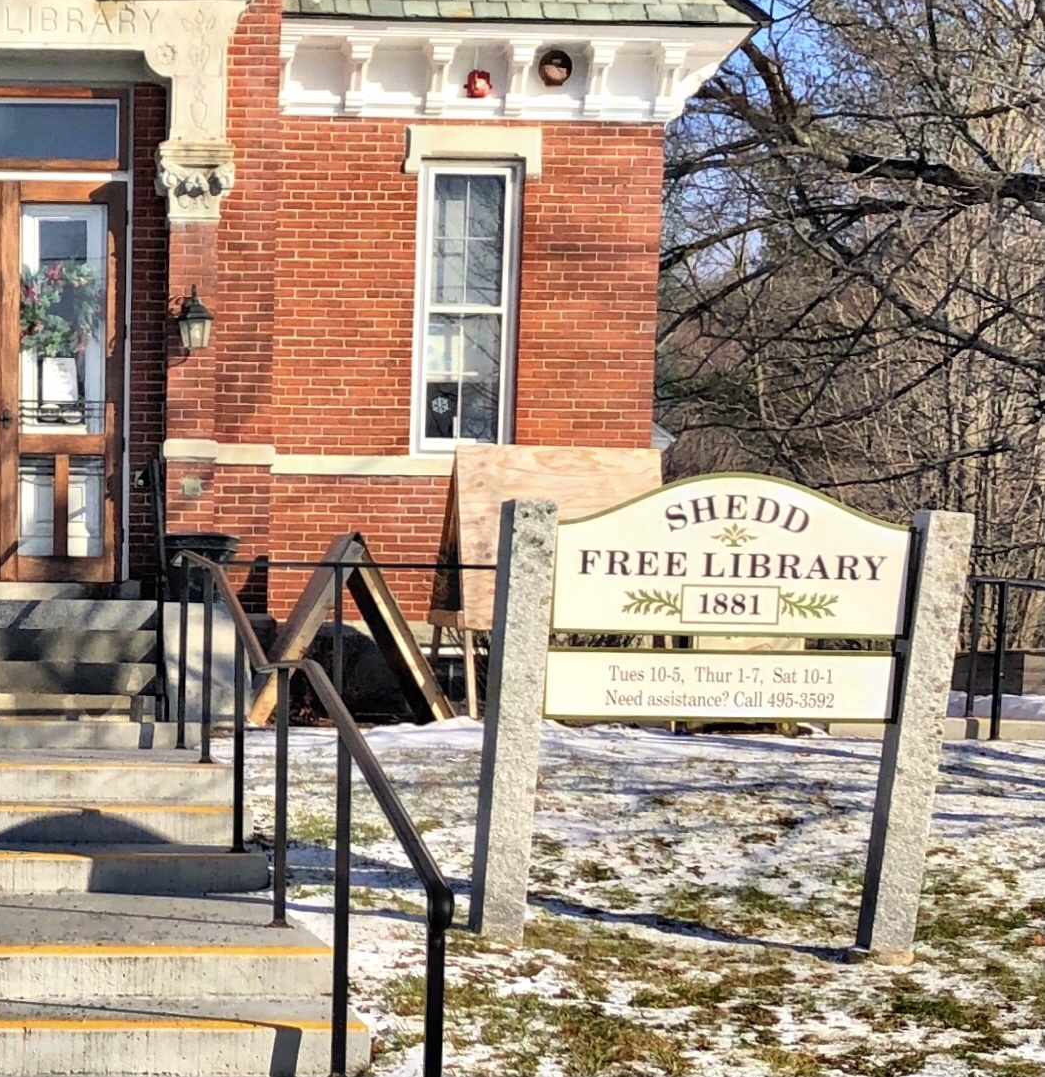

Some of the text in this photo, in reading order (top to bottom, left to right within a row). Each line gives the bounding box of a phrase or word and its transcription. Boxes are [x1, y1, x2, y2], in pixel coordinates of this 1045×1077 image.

[5, 6, 161, 34] LIBRARY
[665, 494, 810, 534] SHEDD
[578, 549, 888, 581] FREE LIBRARY
[698, 592, 763, 616] 1881
[608, 664, 833, 685] Tues 10-5, Thur 1-7, Sat 10-1
[605, 689, 836, 709] Need assistance? Call 495-3592
